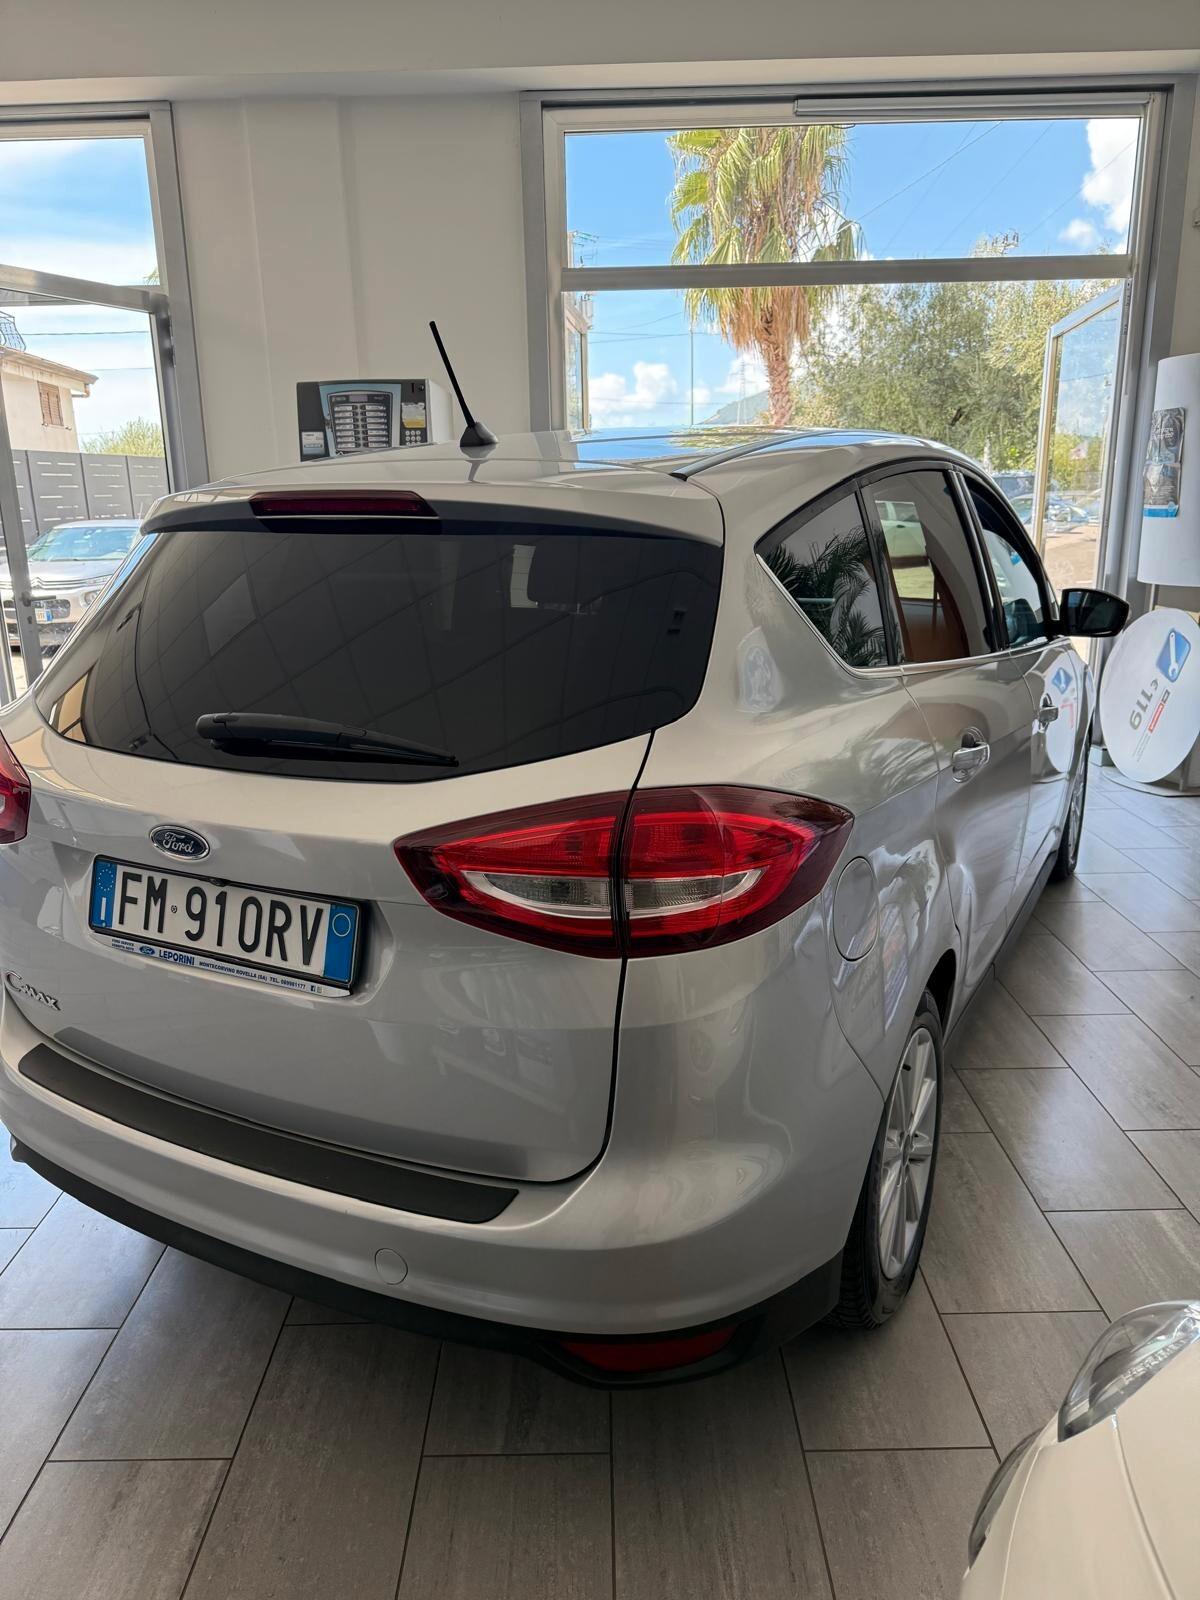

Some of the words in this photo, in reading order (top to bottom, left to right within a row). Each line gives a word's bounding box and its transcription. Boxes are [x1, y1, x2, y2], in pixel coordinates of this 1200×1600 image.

[118, 871, 168, 934] FM
[184, 886, 324, 966] 910RV
[158, 949, 195, 966] LEPORINI
[199, 961, 236, 974] MONTECORVINO
[236, 969, 257, 979] ROVELLA
